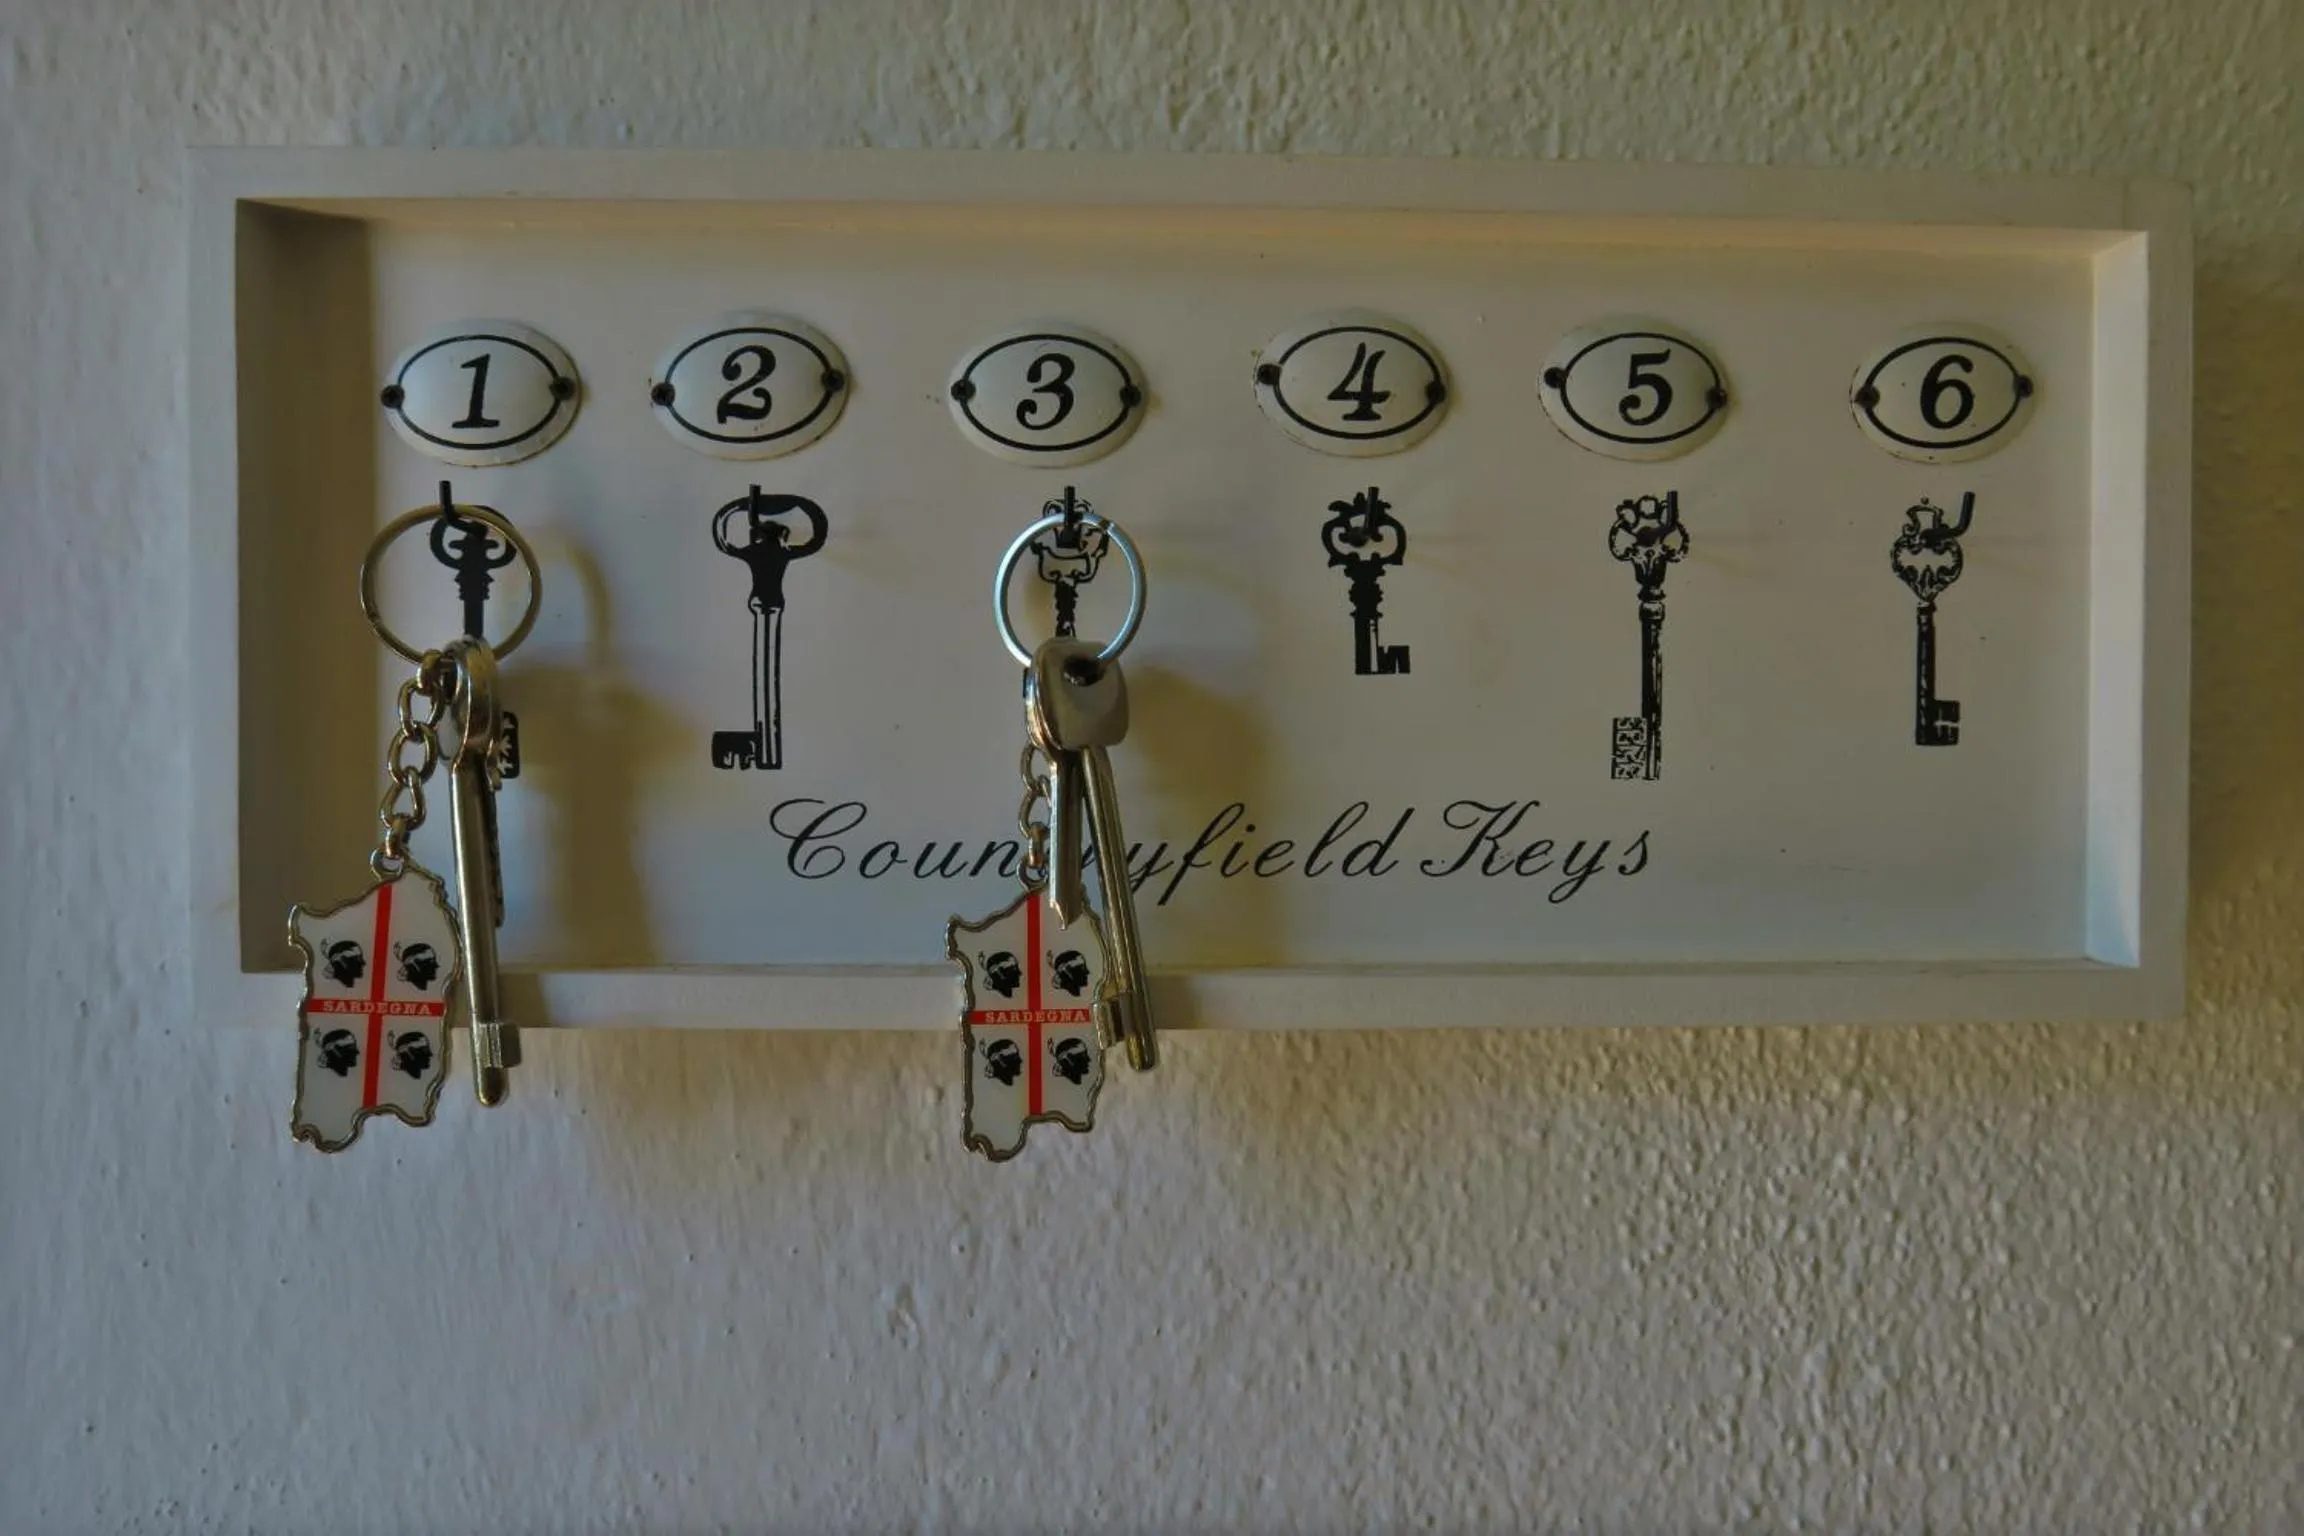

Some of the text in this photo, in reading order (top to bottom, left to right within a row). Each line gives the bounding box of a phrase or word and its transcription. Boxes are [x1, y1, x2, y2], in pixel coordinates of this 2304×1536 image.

[452, 353, 500, 429] 1
[716, 345, 777, 425] 2
[1016, 353, 1075, 430] 3
[1327, 342, 1391, 421] 4
[1618, 349, 1673, 427] 5
[1920, 354, 1976, 430] 6
[769, 798, 1652, 906] Counyfield Keys
[322, 1000, 432, 1016] SARDEGNA
[984, 1010, 1087, 1024] SARDEGNA
